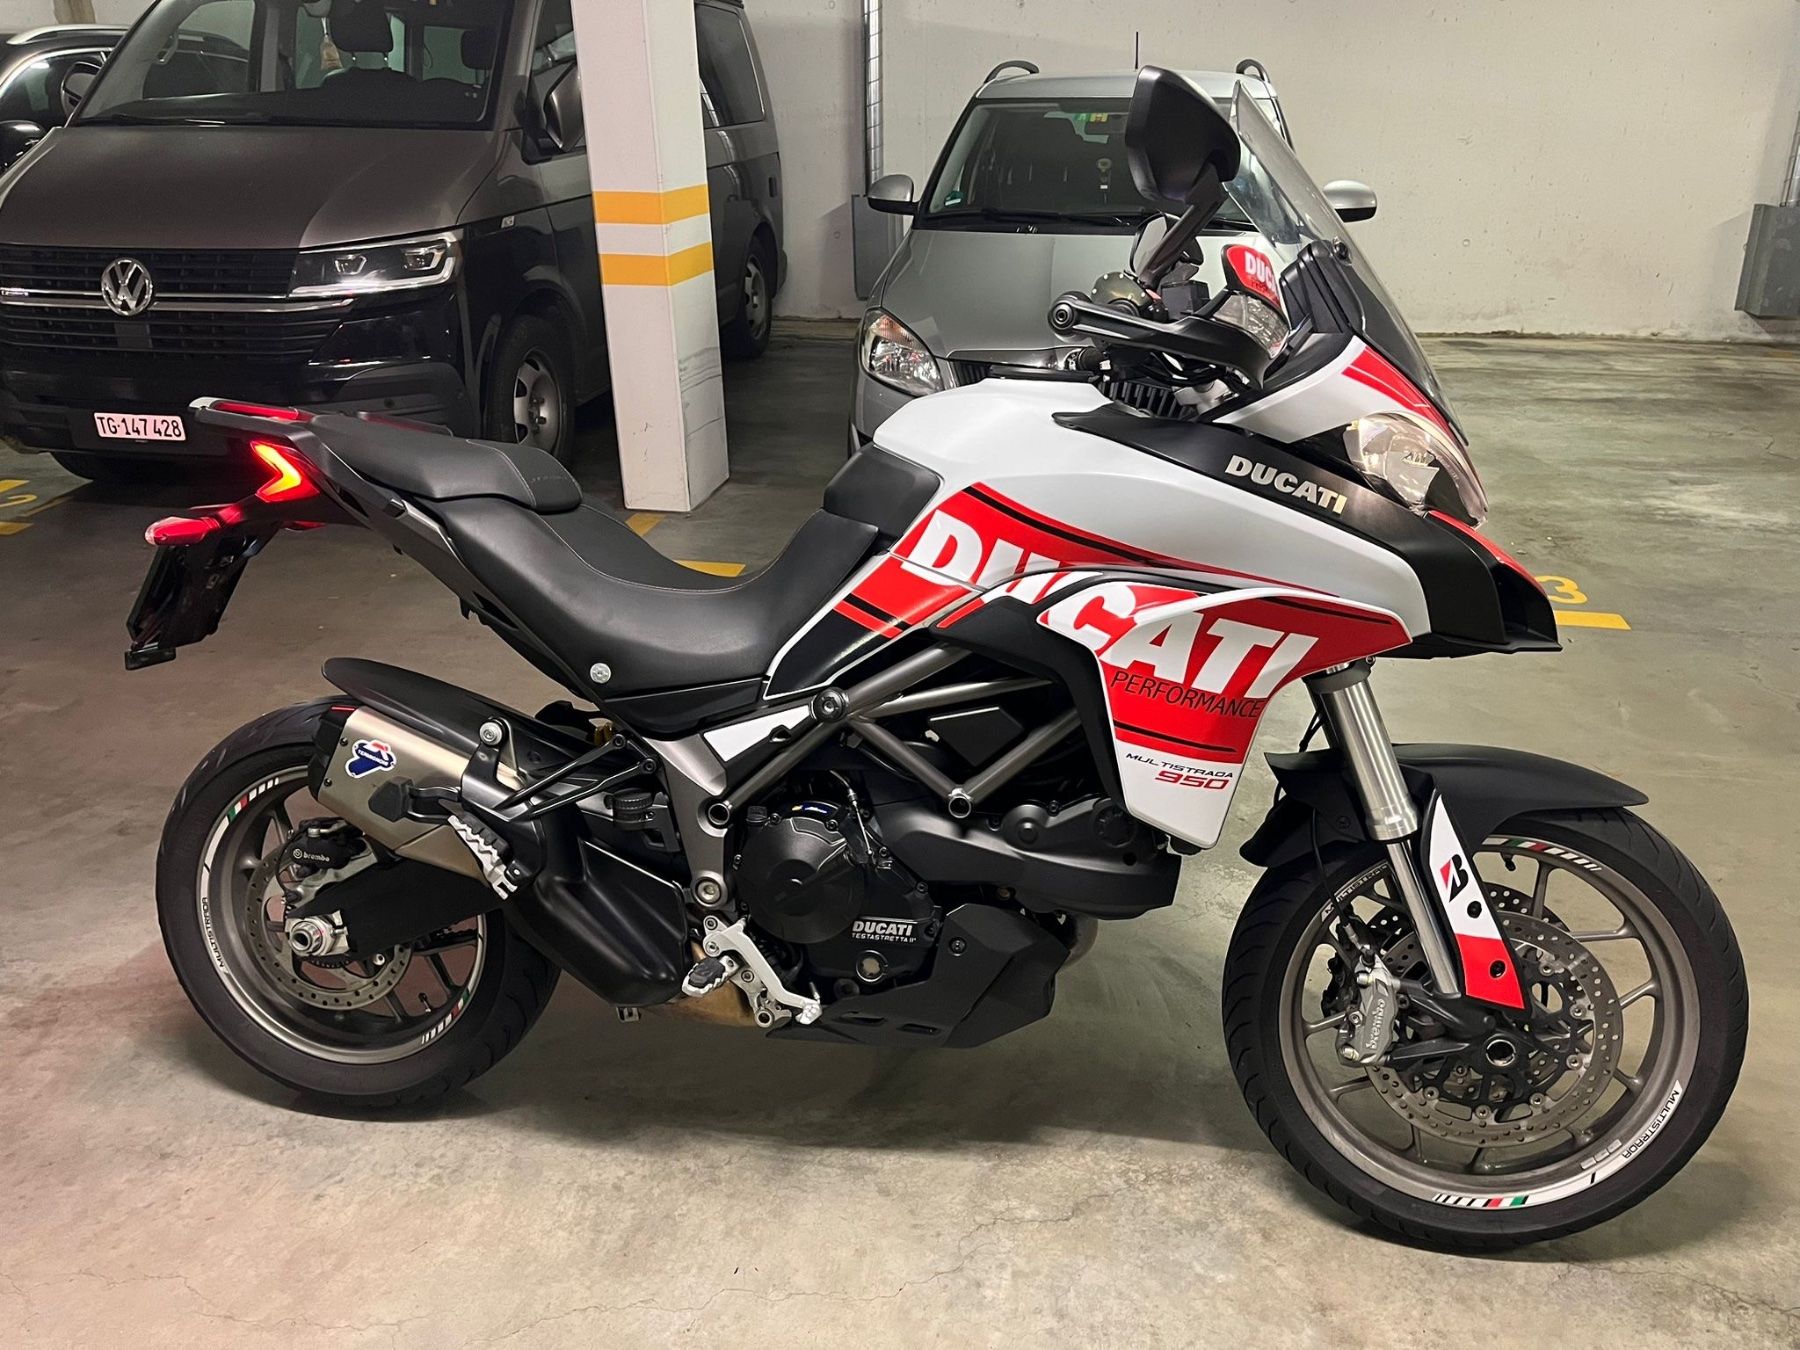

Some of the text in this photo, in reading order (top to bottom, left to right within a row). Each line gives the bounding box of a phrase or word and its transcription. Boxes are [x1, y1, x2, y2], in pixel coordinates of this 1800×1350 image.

[153, 418, 182, 438] 428
[1225, 455, 1348, 514] DUCATI
[902, 509, 1319, 699] DUCATI
[1110, 671, 1262, 718] PERFORMANCE
[1126, 753, 1233, 778] MULTISTRADA
[1155, 770, 1229, 790] 950
[303, 851, 330, 862] brembo
[852, 920, 913, 937] DUCATI
[852, 932, 908, 943] TESTASTRETTA
[1365, 999, 1385, 1049] brembo
[1622, 1089, 1680, 1159] MULTISTRADA
